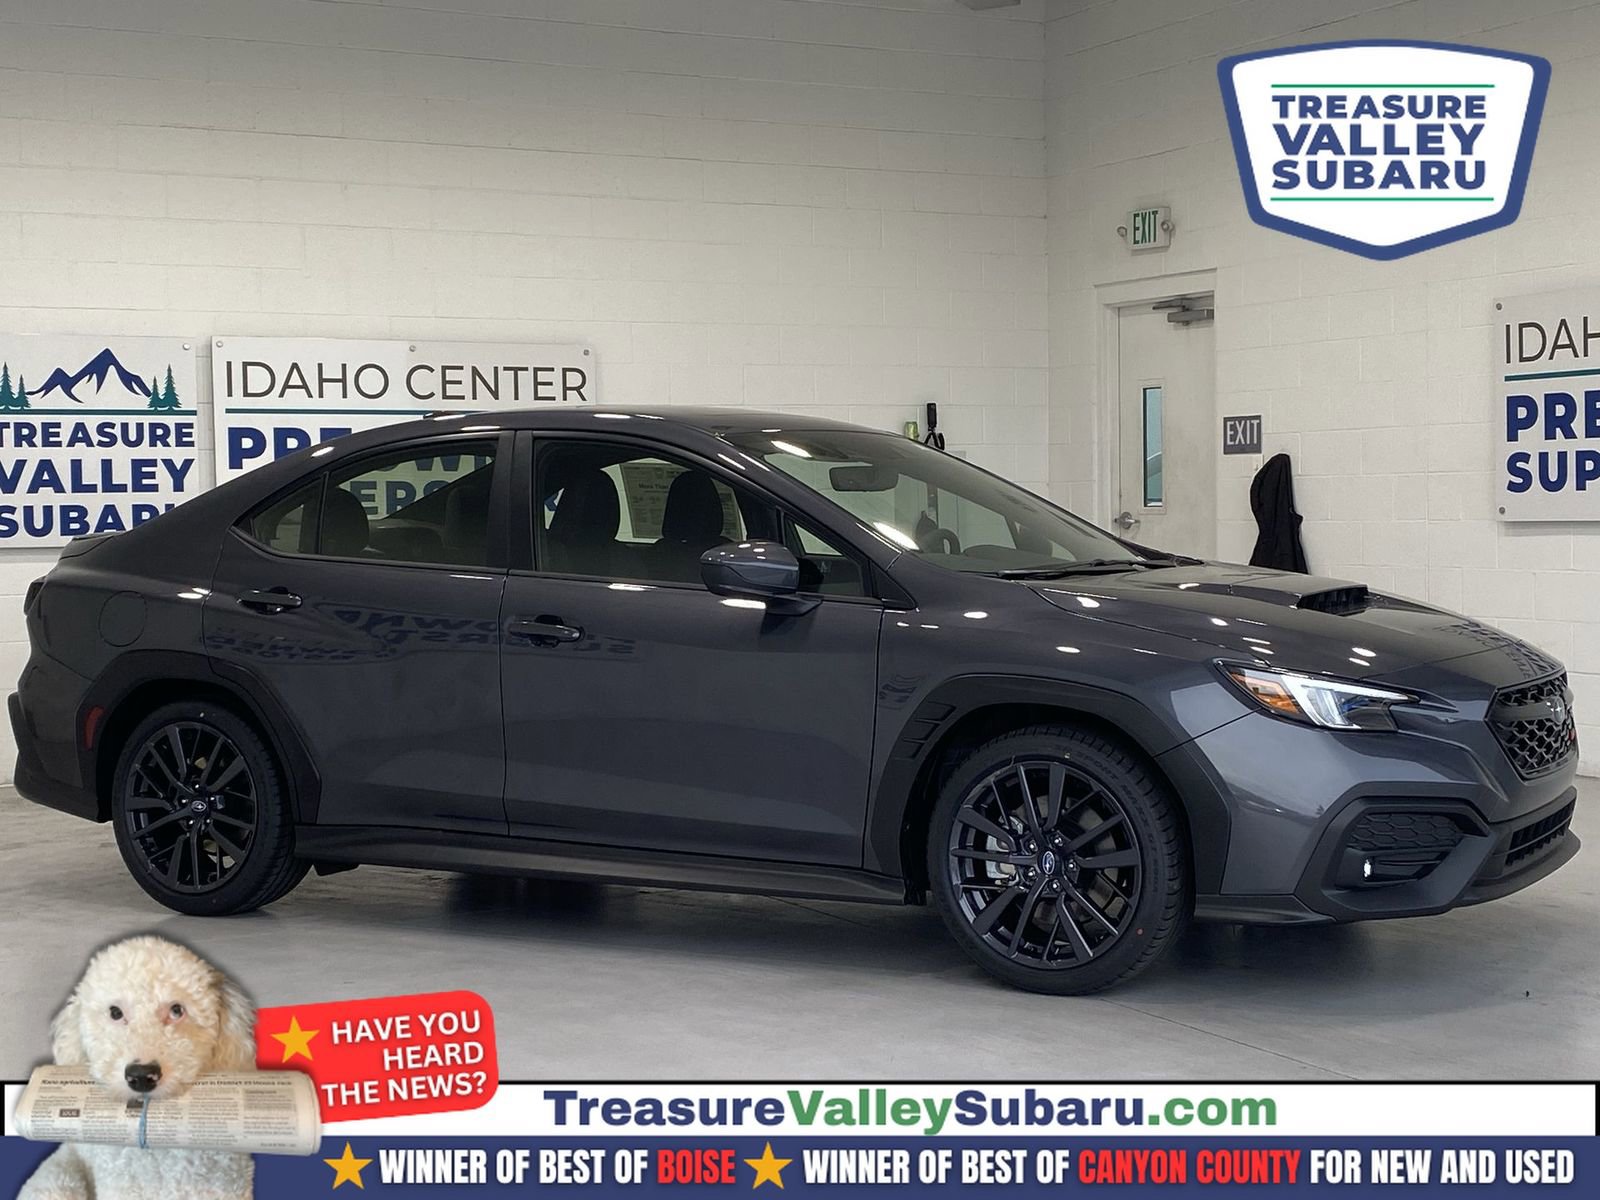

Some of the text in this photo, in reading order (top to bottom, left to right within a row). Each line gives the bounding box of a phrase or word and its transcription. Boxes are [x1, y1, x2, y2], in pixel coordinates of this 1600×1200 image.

[1133, 210, 1158, 245] EXIT
[226, 361, 588, 401] IDAHO CENTER
[1226, 419, 1260, 446] EXIT
[0, 458, 196, 494] VALLEY
[0, 504, 177, 538] SUBAR
